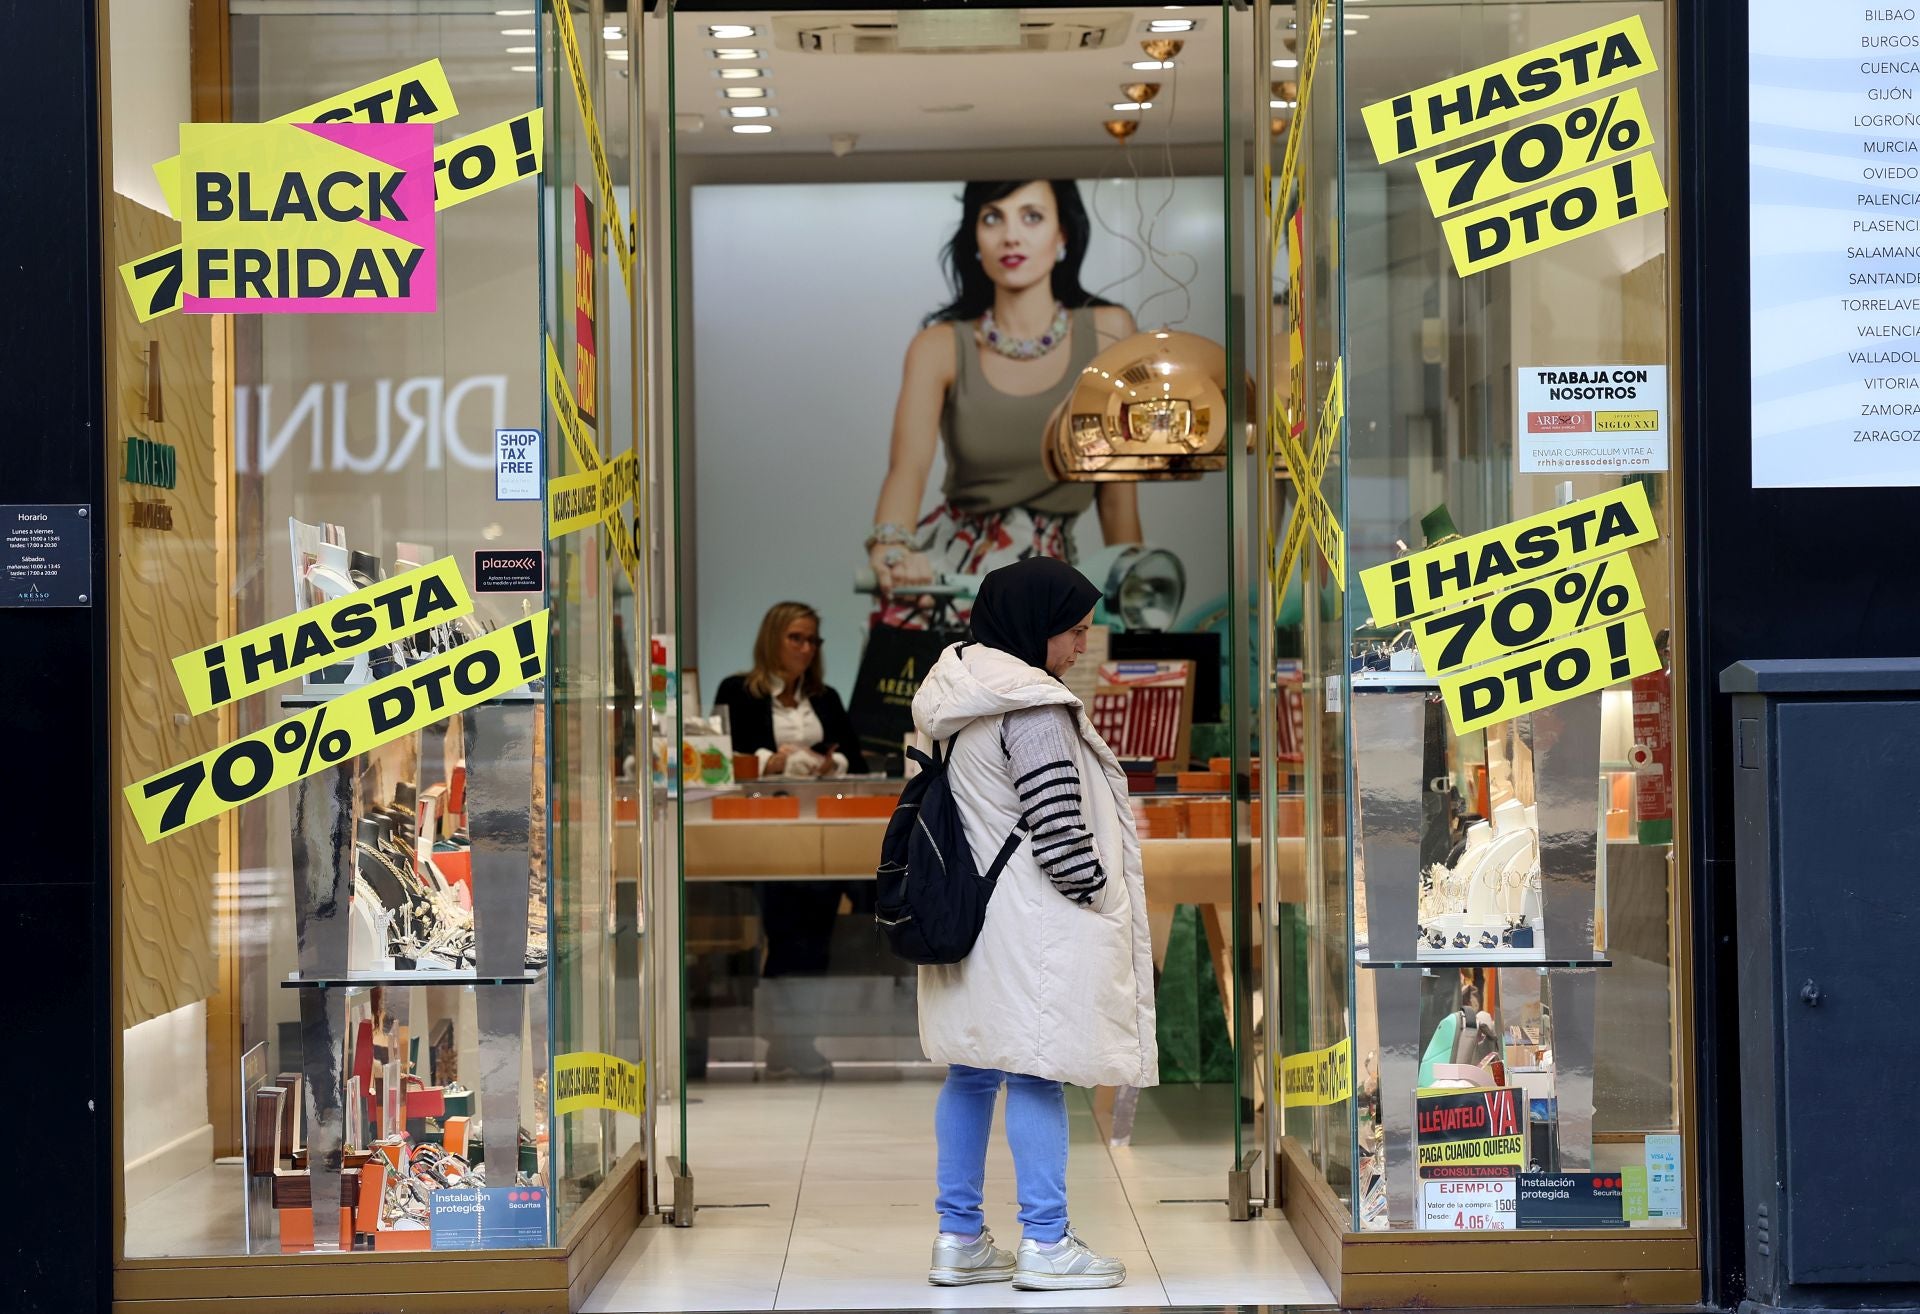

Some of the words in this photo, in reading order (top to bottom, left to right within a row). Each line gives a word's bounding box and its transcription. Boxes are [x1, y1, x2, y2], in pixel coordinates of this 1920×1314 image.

[1865, 9, 1915, 21] BILBAO
[1861, 35, 1919, 47] BURGOS
[1860, 62, 1920, 74] CUENCA
[1868, 86, 1912, 100] GIJÓN
[1435, 96, 1641, 209] 70%
[1864, 141, 1918, 153] MURCIA
[1863, 167, 1918, 179] OVIEDO
[196, 171, 408, 222] BLACK
[1853, 220, 1920, 232] PLASENCI
[198, 248, 425, 298] FRIDAY
[1841, 299, 1920, 311] TORRELAVE
[1537, 371, 1609, 385] TRABAJA
[1612, 370, 1648, 383] CON
[1864, 378, 1919, 389] VITORIA
[1550, 386, 1637, 400] NOSOTROS
[1861, 404, 1920, 416] ZAMORA
[1598, 420, 1631, 430] SIGLO
[1634, 420, 1656, 429] XXI
[500, 434, 537, 447] SHOP
[500, 447, 526, 460] TAX
[1532, 448, 1563, 458] ENVIAR
[1564, 447, 1621, 457] CURRICULUM
[1622, 447, 1645, 456] VITAE
[500, 462, 534, 474] FREE
[1537, 457, 1650, 467] rrhh@aressodesign.com
[18, 513, 48, 521] Horario
[482, 557, 523, 571] plazox
[1425, 562, 1630, 673] 70%
[143, 707, 352, 834] 70%
[1420, 1105, 1485, 1133] LLÉVATELO
[1484, 1089, 1519, 1137] YA
[1420, 1146, 1443, 1163] PAGA
[1445, 1142, 1481, 1161] CUANDO
[1483, 1137, 1521, 1157] QUIERAS
[1440, 1183, 1503, 1193] EJEMPLO
[1521, 1177, 1575, 1187] Instalación
[436, 1193, 491, 1203] Instalación
[1521, 1189, 1570, 1200] protegida
[436, 1203, 485, 1215] protegida
[1464, 1202, 1493, 1210] compra:
